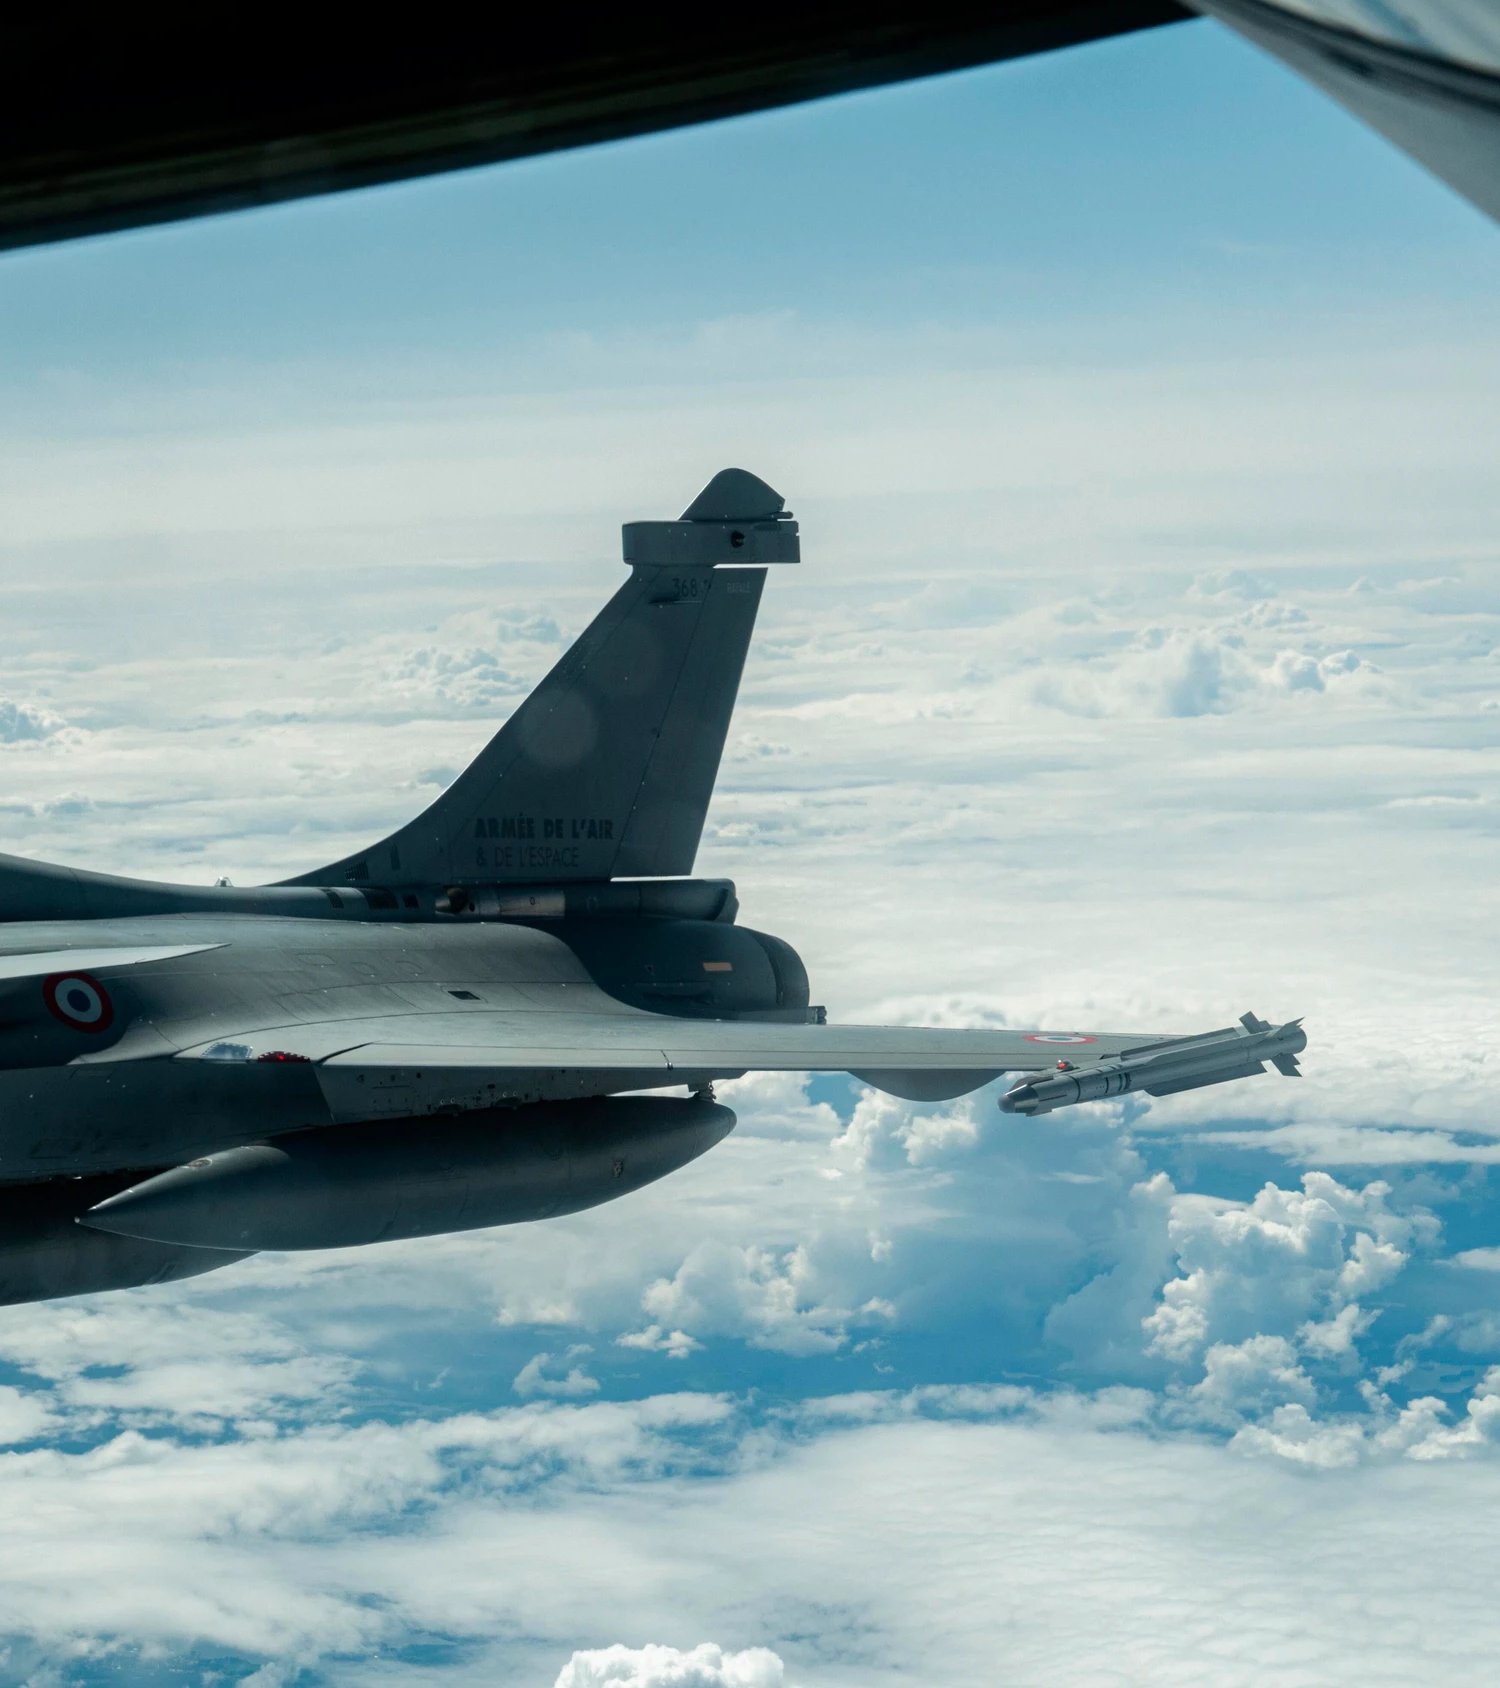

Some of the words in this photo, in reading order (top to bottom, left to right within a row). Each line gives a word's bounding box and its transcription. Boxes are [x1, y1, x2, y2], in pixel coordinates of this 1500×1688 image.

[672, 577, 698, 598] 368
[474, 812, 535, 838] ARMÉE
[543, 818, 564, 838] DE
[572, 818, 614, 839] L'AIR
[476, 846, 486, 867] &
[495, 846, 512, 867] DE
[520, 846, 579, 867] L'ESPACE
